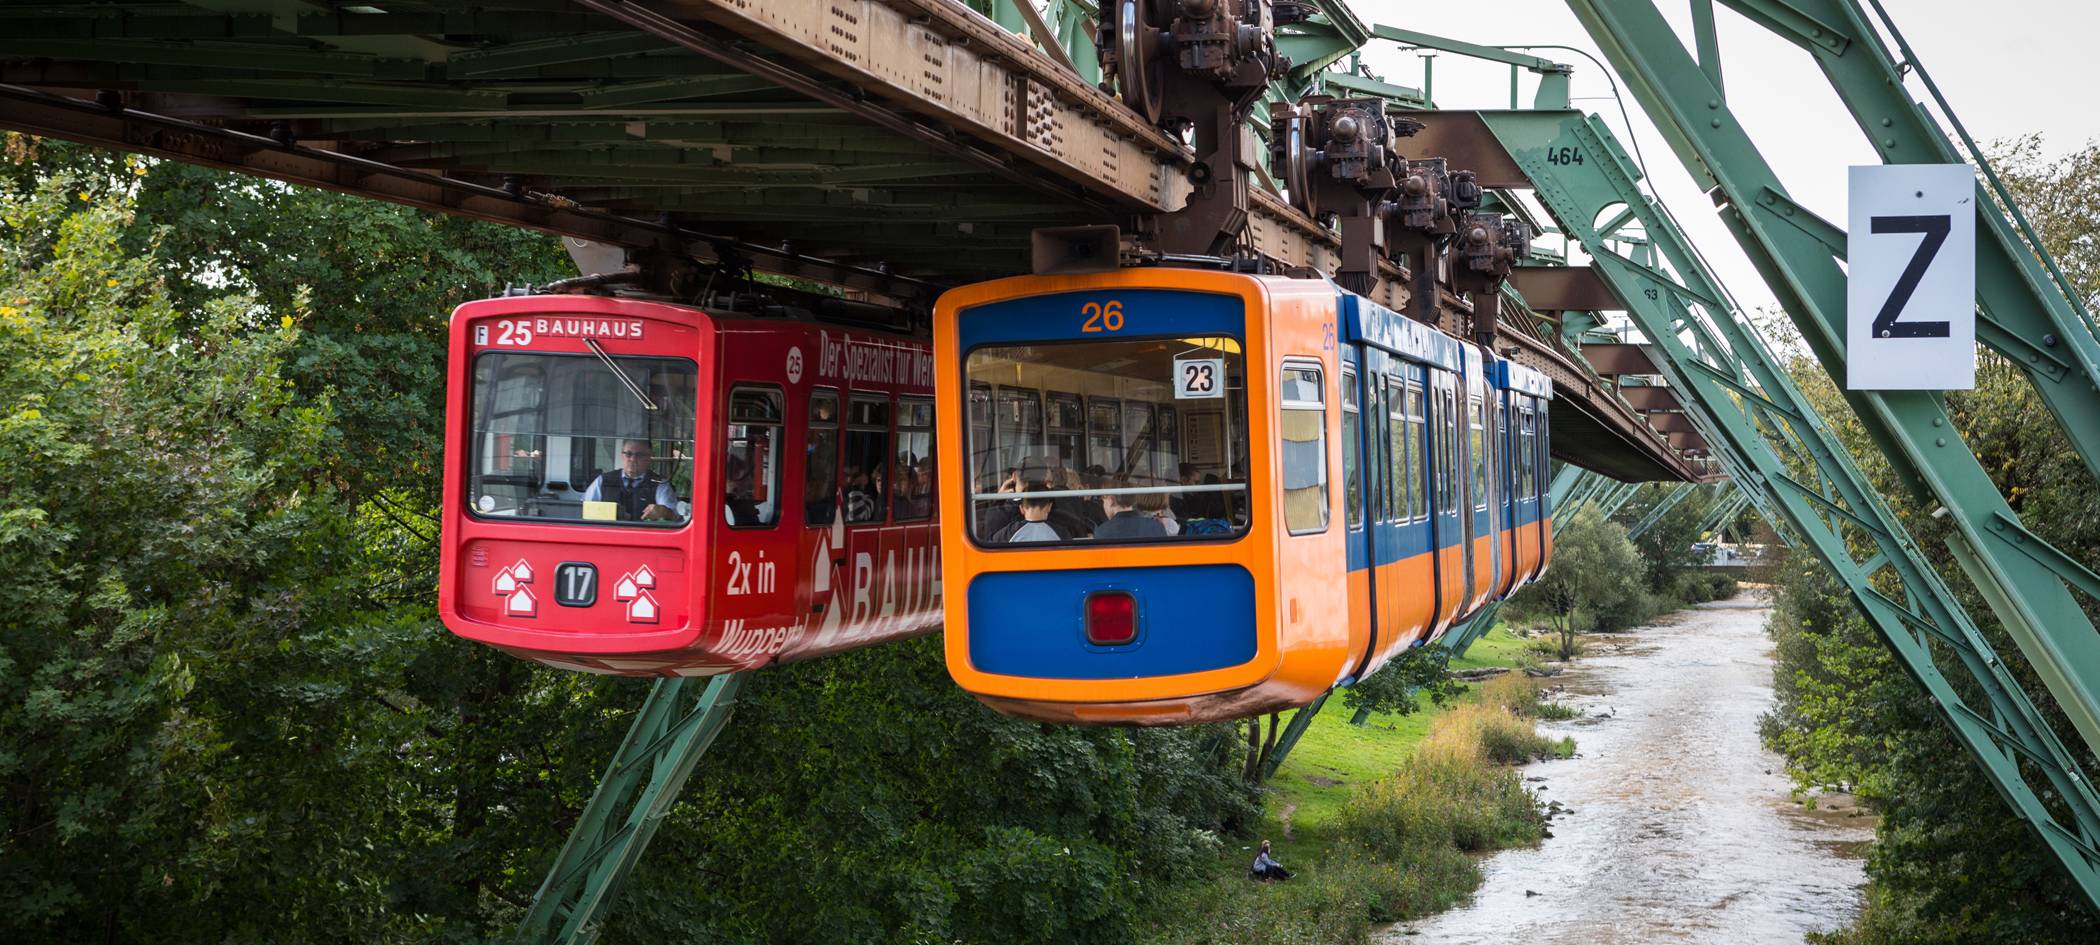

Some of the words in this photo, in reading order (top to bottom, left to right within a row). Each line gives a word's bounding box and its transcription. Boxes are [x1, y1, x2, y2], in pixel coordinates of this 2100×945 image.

[1546, 147, 1584, 166] 464
[1871, 214, 1951, 338] Z
[1081, 300, 1125, 333] 26
[477, 327, 486, 343] F
[497, 320, 533, 346] 25
[536, 319, 642, 337] BAUHAUS
[1322, 322, 1336, 351] 26
[788, 355, 801, 375] 25
[819, 330, 841, 379] Der
[843, 333, 895, 389] Spezialist
[1185, 365, 1214, 392] 23
[564, 566, 593, 601] 17
[727, 551, 751, 595] 2x
[757, 550, 776, 594] in
